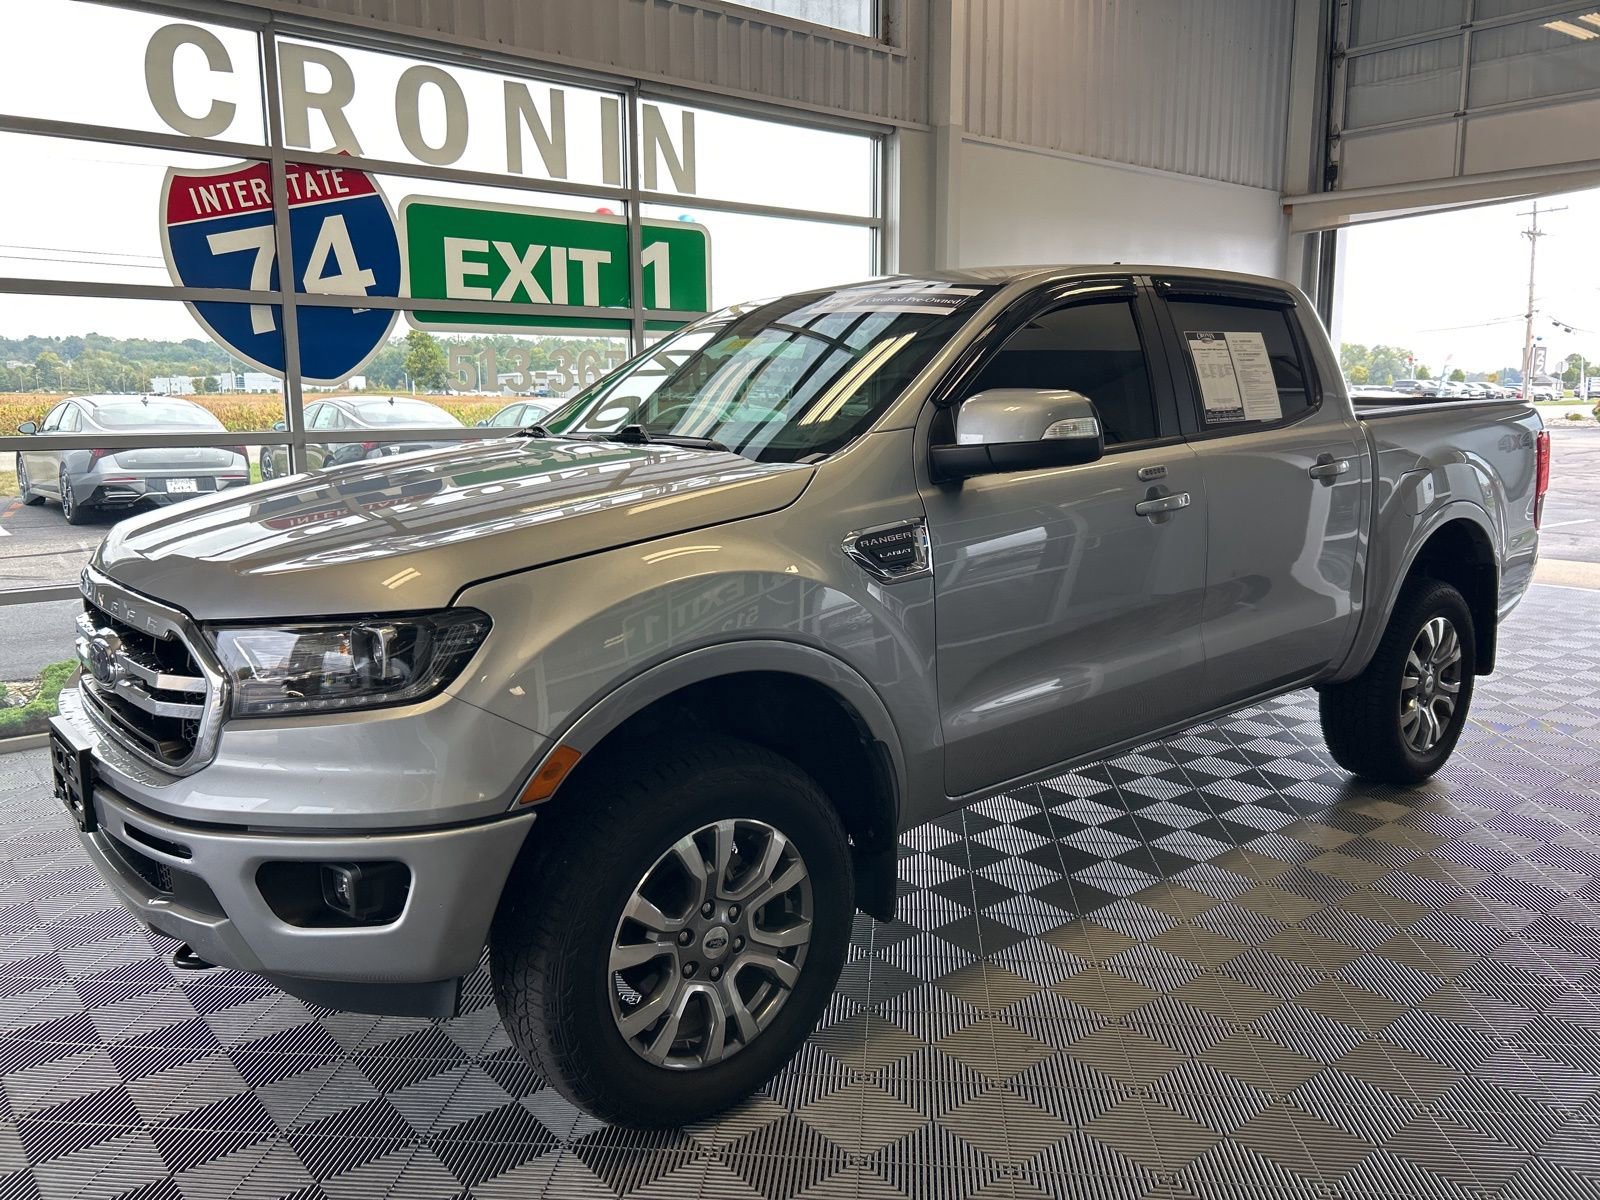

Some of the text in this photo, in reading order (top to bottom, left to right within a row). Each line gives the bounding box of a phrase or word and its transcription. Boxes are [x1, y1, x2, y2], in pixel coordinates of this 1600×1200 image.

[145, 23, 697, 195] CRONIN
[188, 168, 350, 215] INTERTATE
[206, 214, 377, 335] 74
[443, 236, 671, 309] EXIT 1
[860, 531, 912, 548] RANGER
